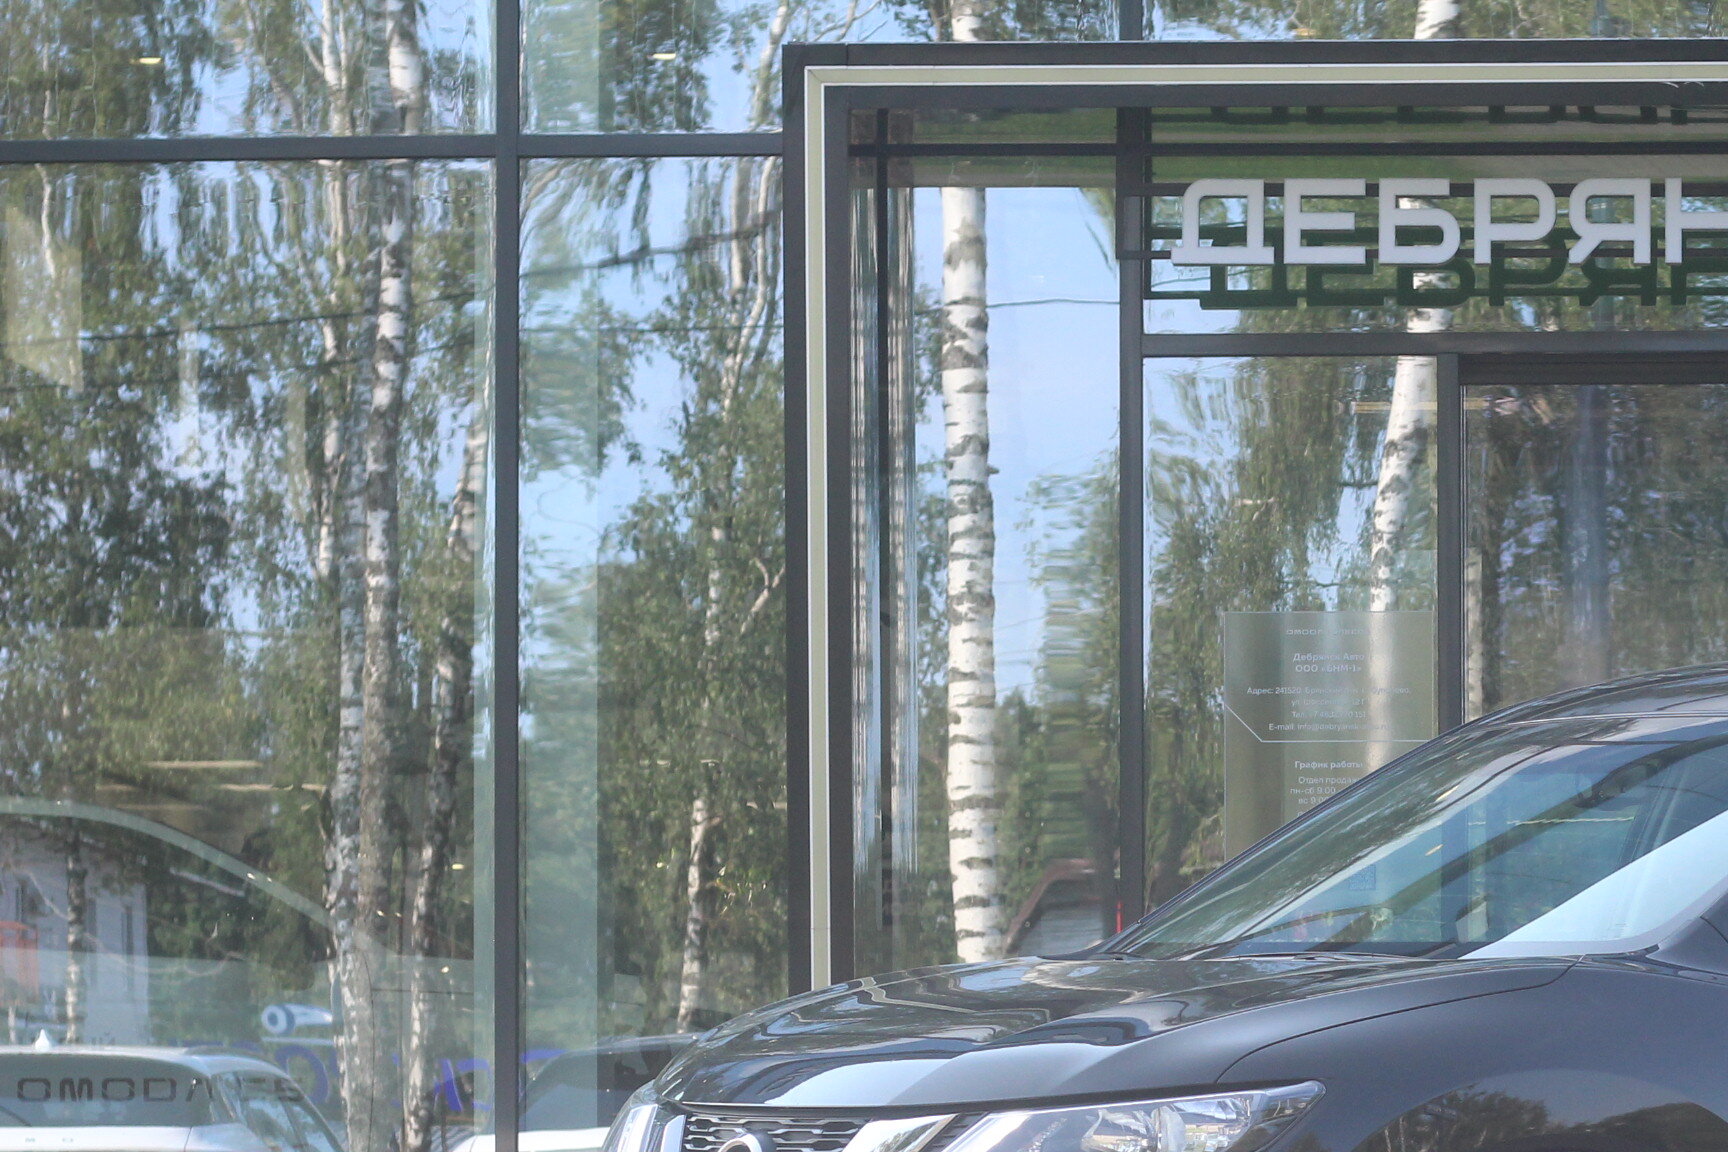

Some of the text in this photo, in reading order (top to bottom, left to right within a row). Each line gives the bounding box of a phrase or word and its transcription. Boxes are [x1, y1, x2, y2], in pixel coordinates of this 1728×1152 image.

[1295, 664, 1318, 673] ООО
[1294, 761, 1363, 770] График работы
